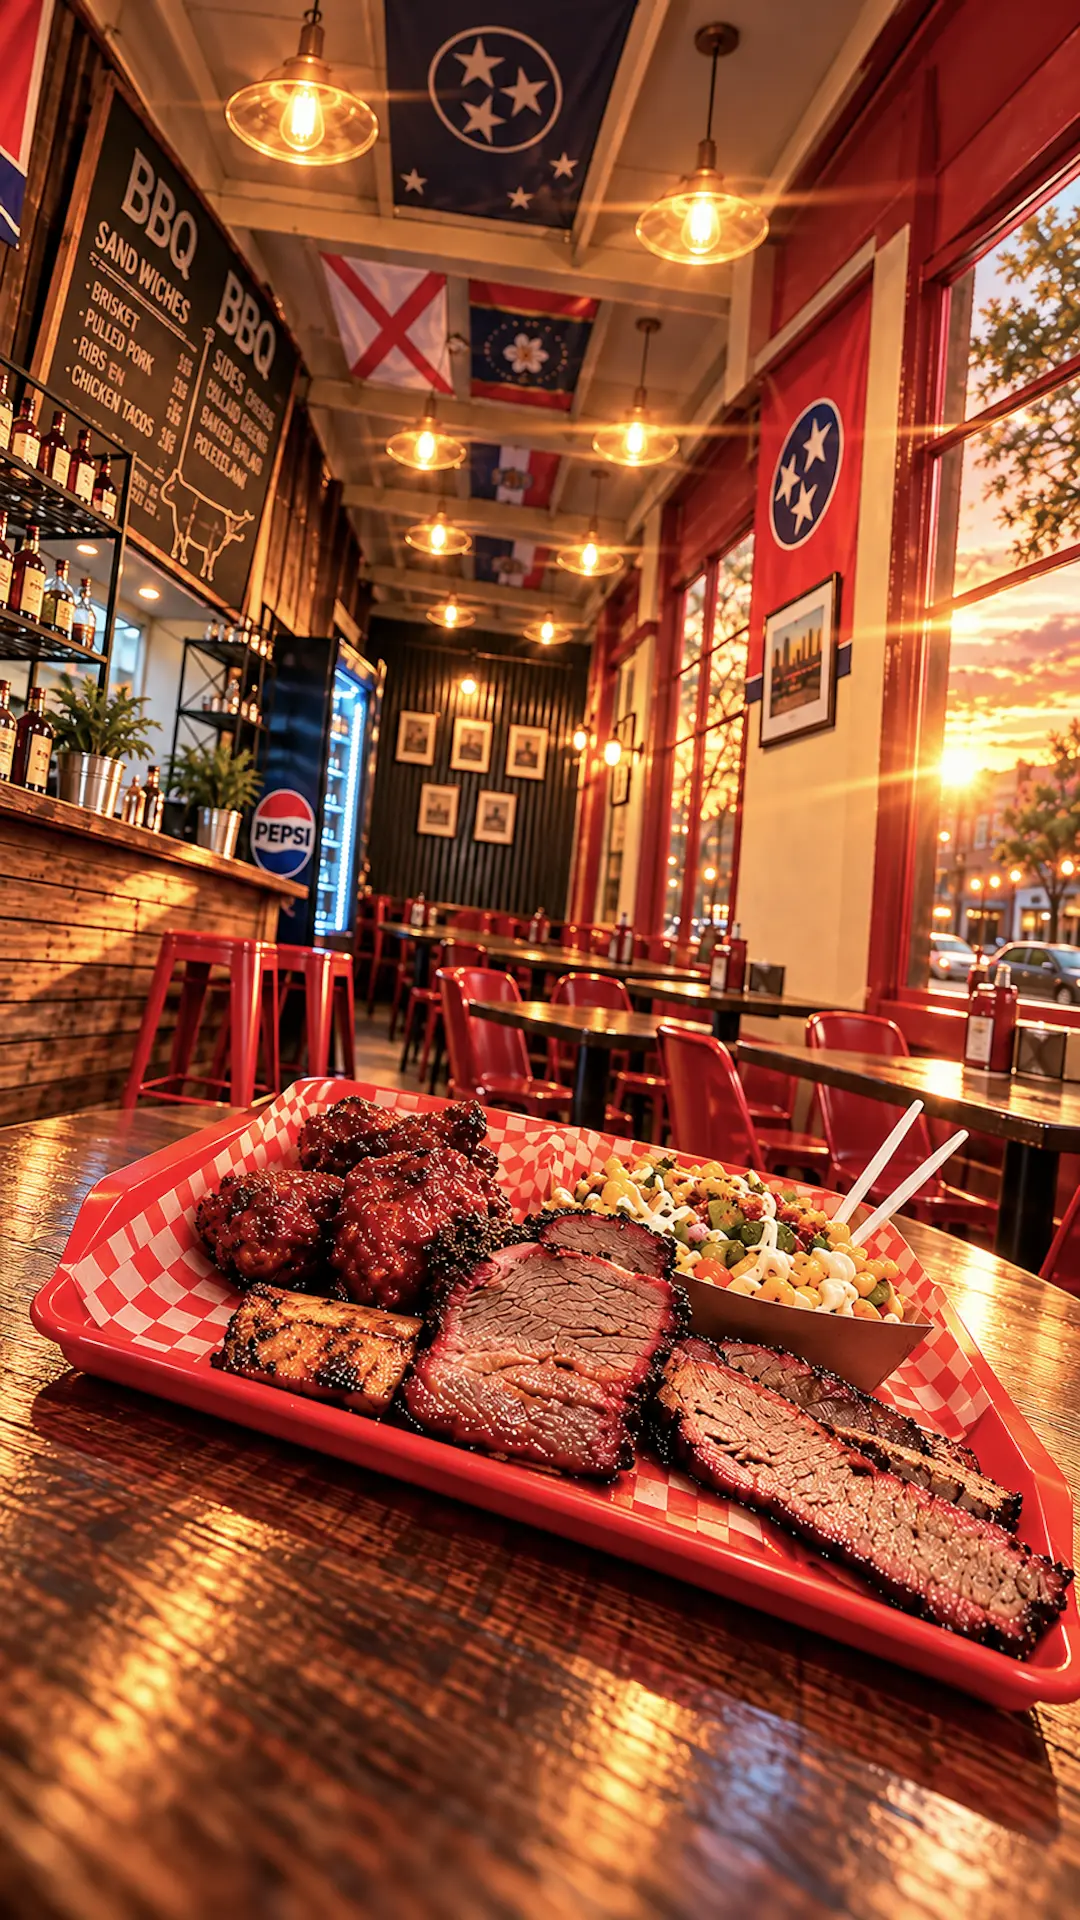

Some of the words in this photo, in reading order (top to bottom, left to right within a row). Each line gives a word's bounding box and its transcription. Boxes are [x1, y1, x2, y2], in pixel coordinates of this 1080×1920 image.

[121, 147, 198, 281] BBQ
[91, 280, 140, 332] BRISKET
[95, 221, 138, 275] SAND
[138, 258, 191, 324] WICHES
[78, 335, 108, 371] RIBS
[84, 308, 125, 352] PULLED
[125, 339, 155, 376] PORK
[216, 269, 276, 381] BBQ
[71, 365, 122, 414] CHICKEN
[121, 399, 155, 438] TACOS
[212, 349, 246, 396] SIDES
[255, 821, 312, 847] PEPSI
